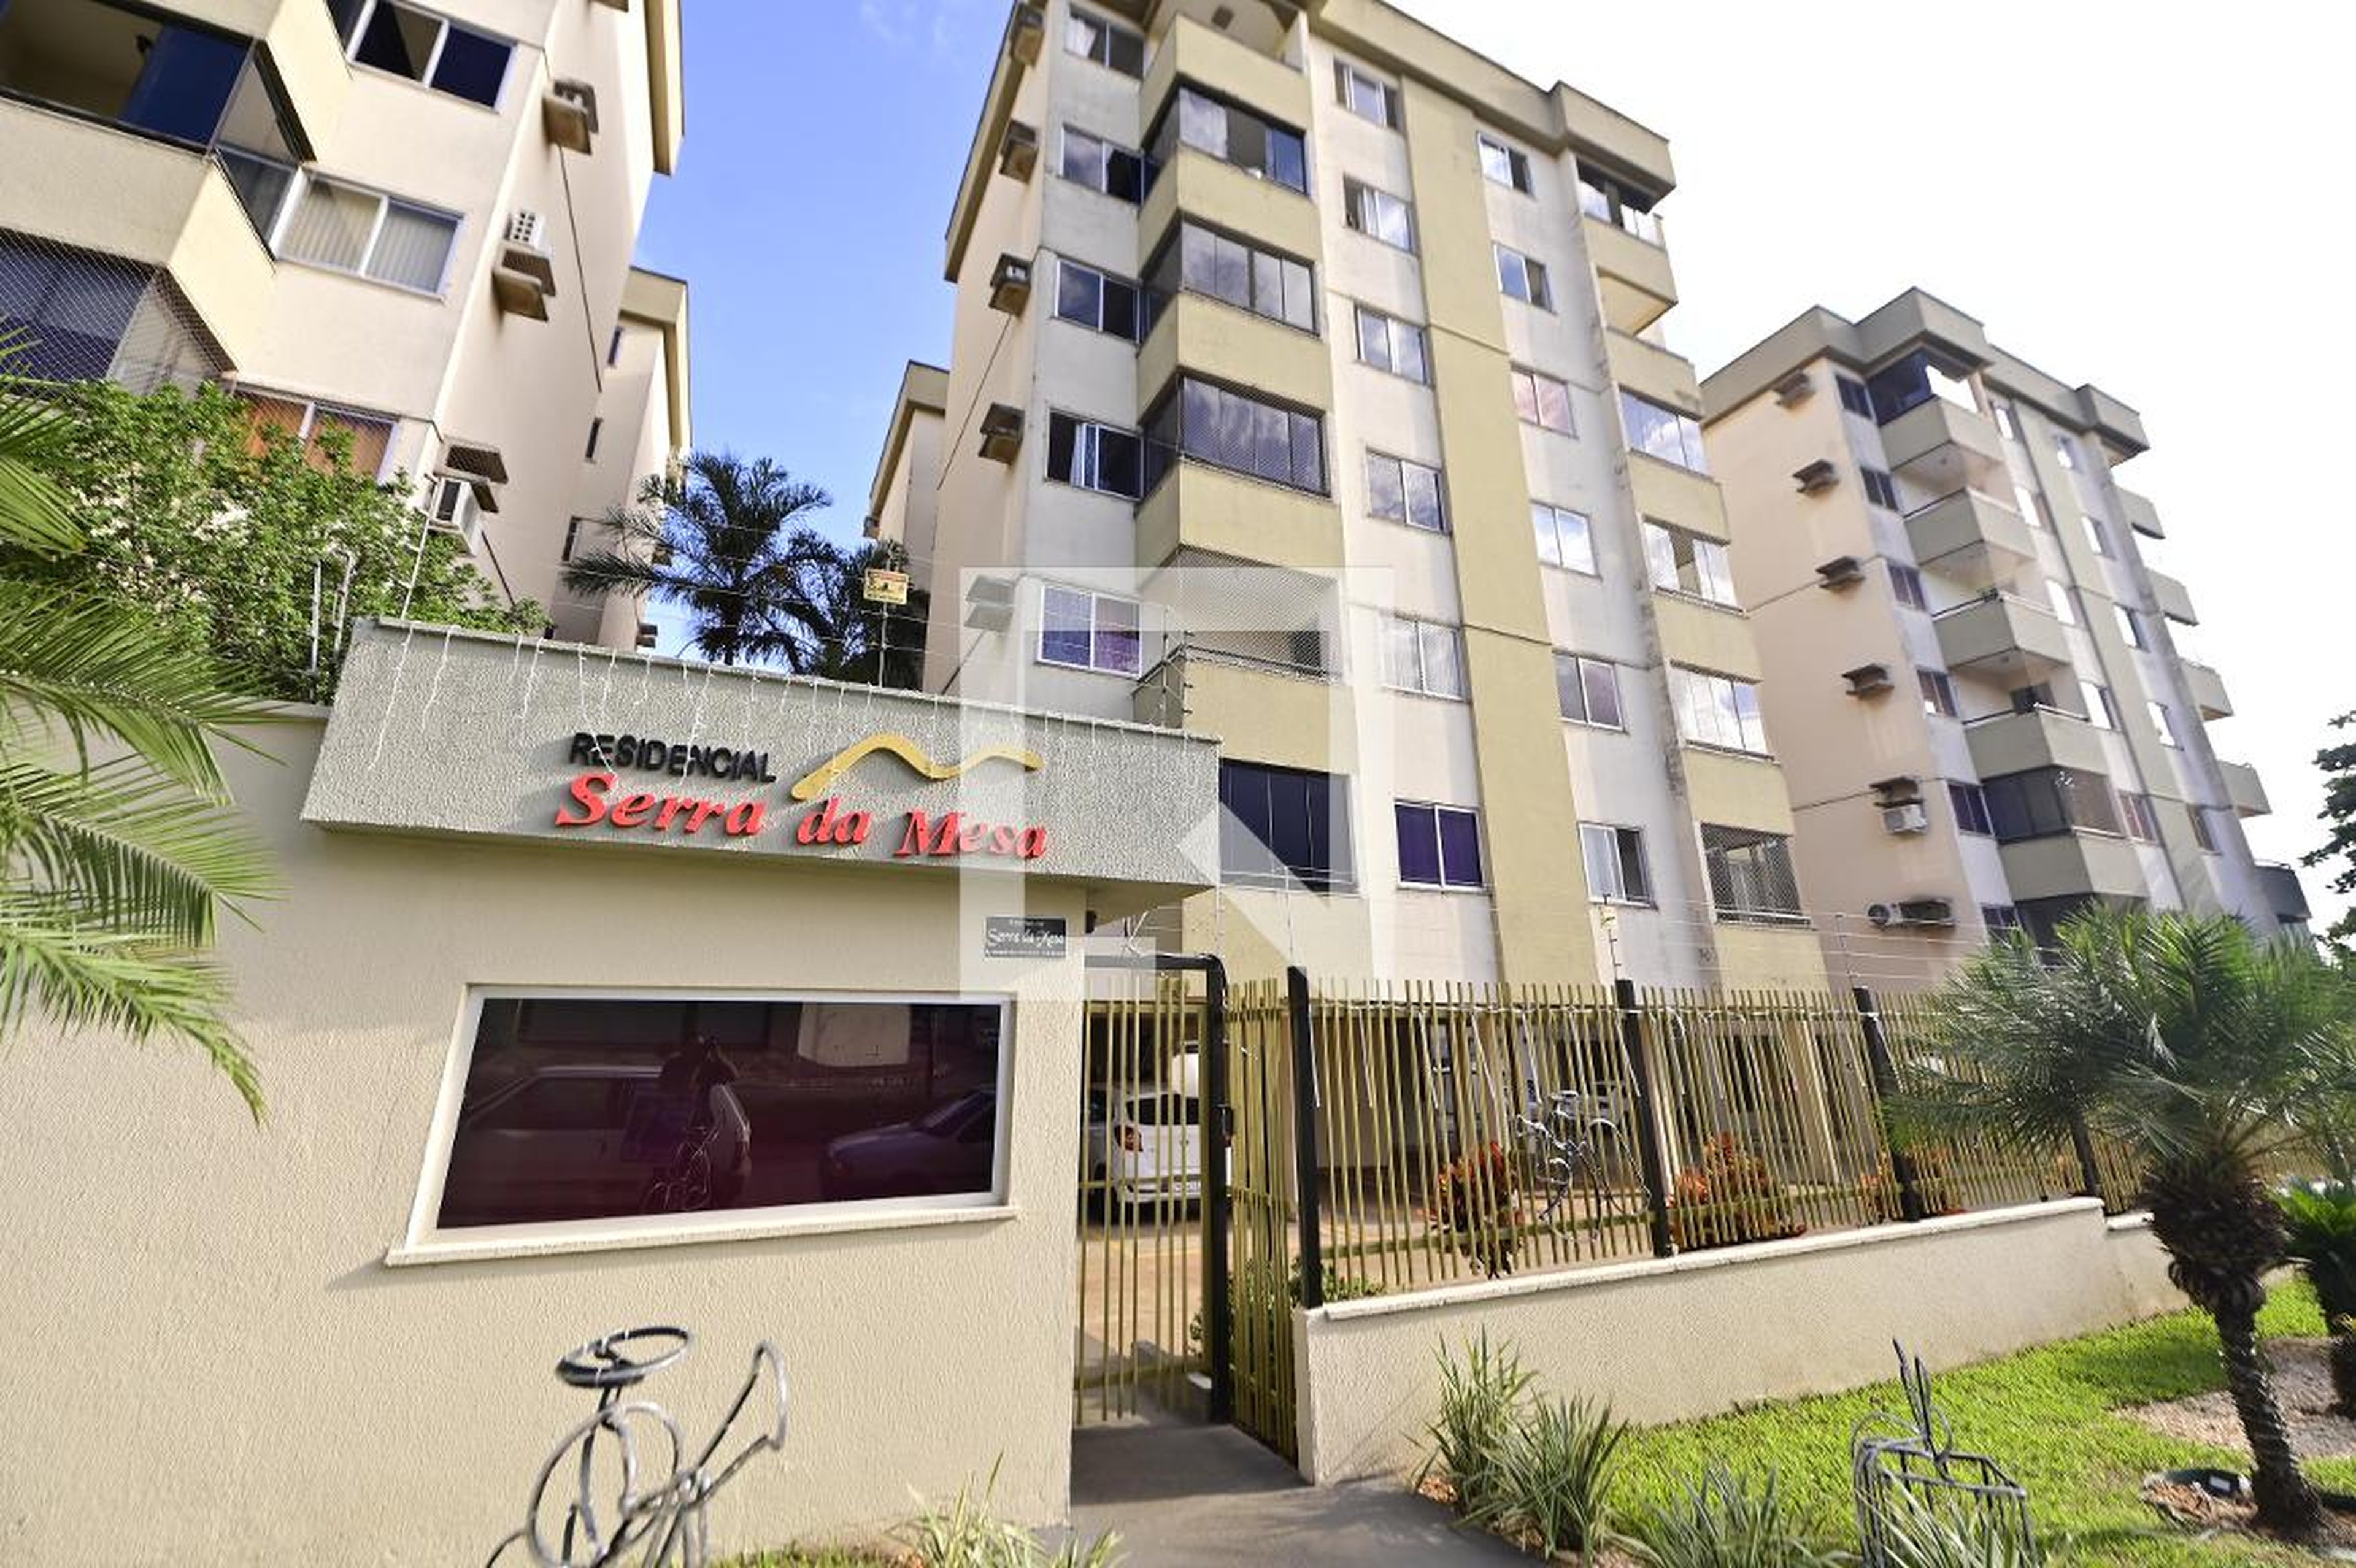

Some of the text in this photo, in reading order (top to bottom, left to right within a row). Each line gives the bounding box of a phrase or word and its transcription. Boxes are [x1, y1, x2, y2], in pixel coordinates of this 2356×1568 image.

[568, 732, 777, 783] RESIDENCIAL
[555, 772, 1047, 858] Serra da Mesa
